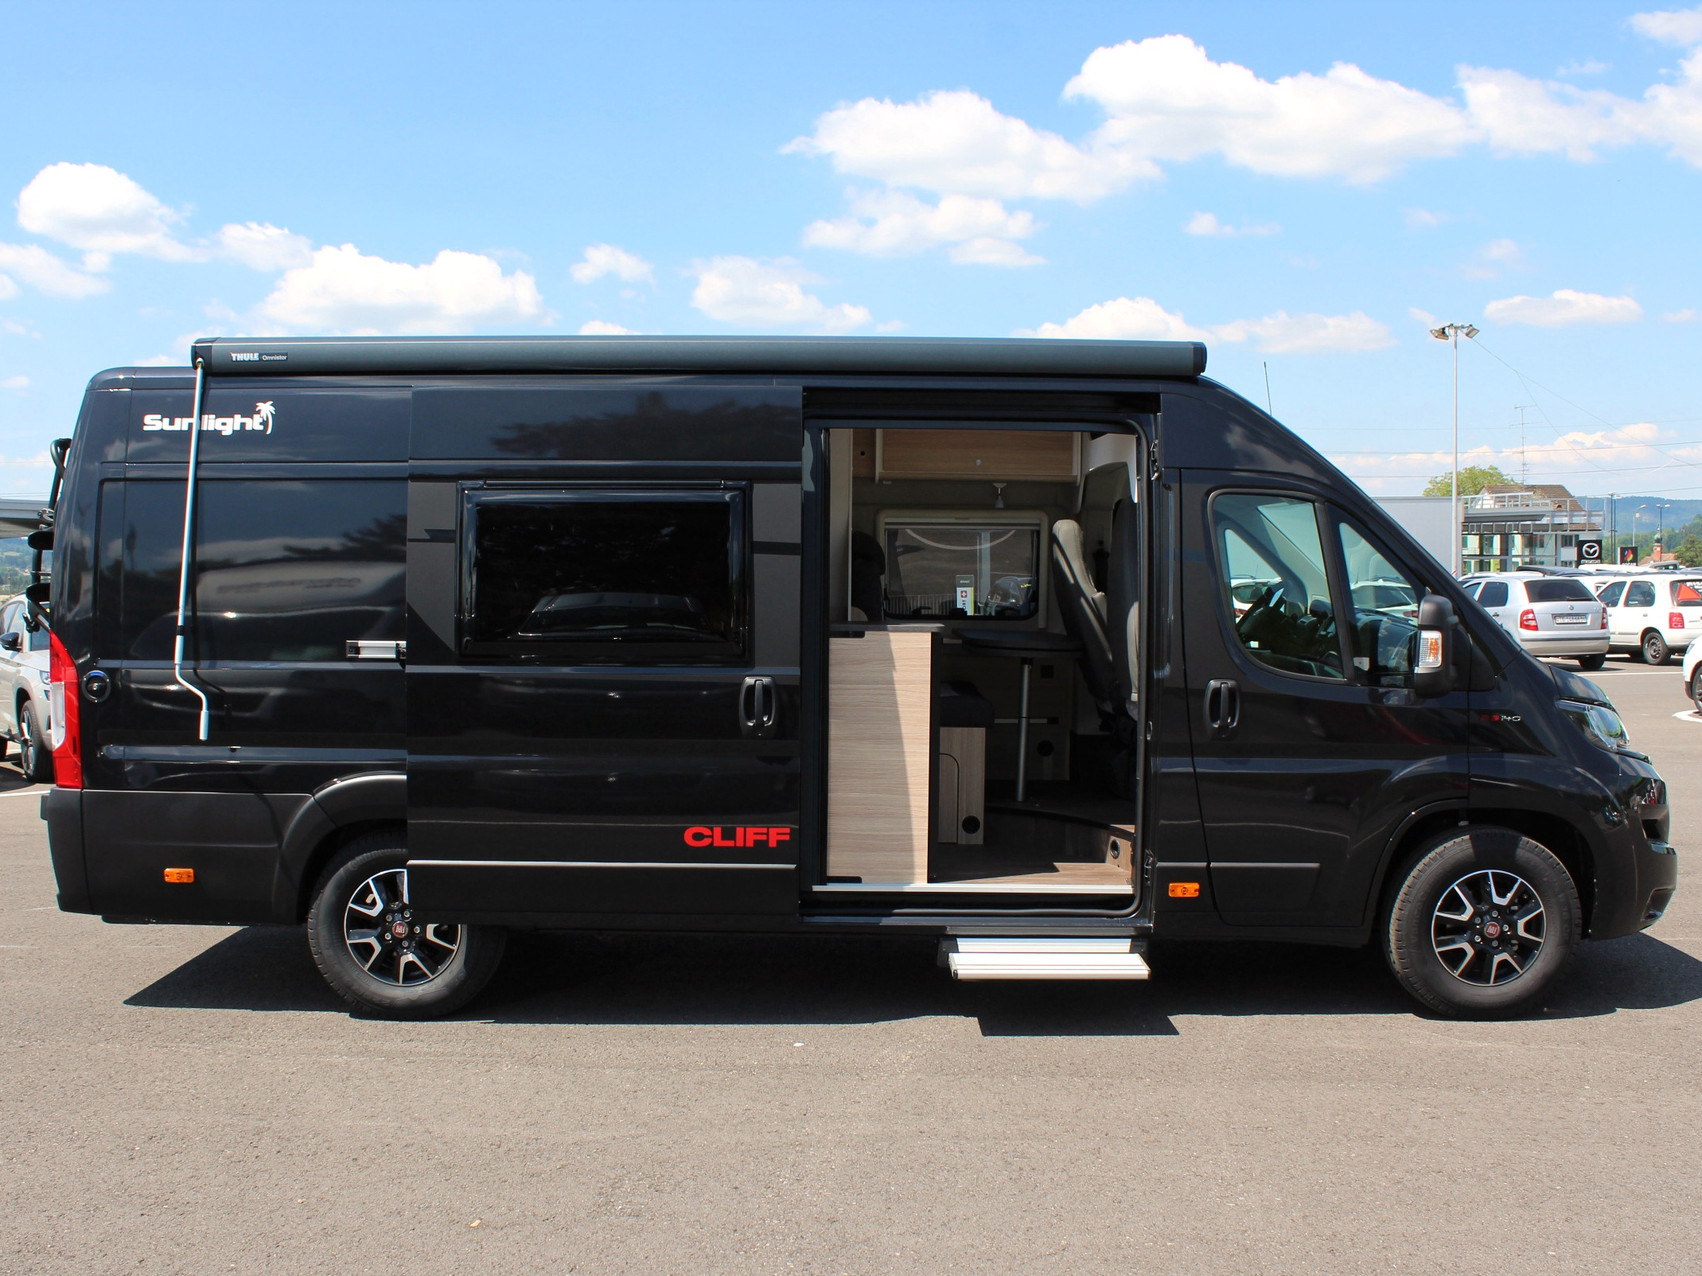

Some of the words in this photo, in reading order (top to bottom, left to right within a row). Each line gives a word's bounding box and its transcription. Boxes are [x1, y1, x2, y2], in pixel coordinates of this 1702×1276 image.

[230, 352, 260, 361] THULE
[143, 414, 264, 435] Sunlight
[683, 826, 791, 848] CLIFF
